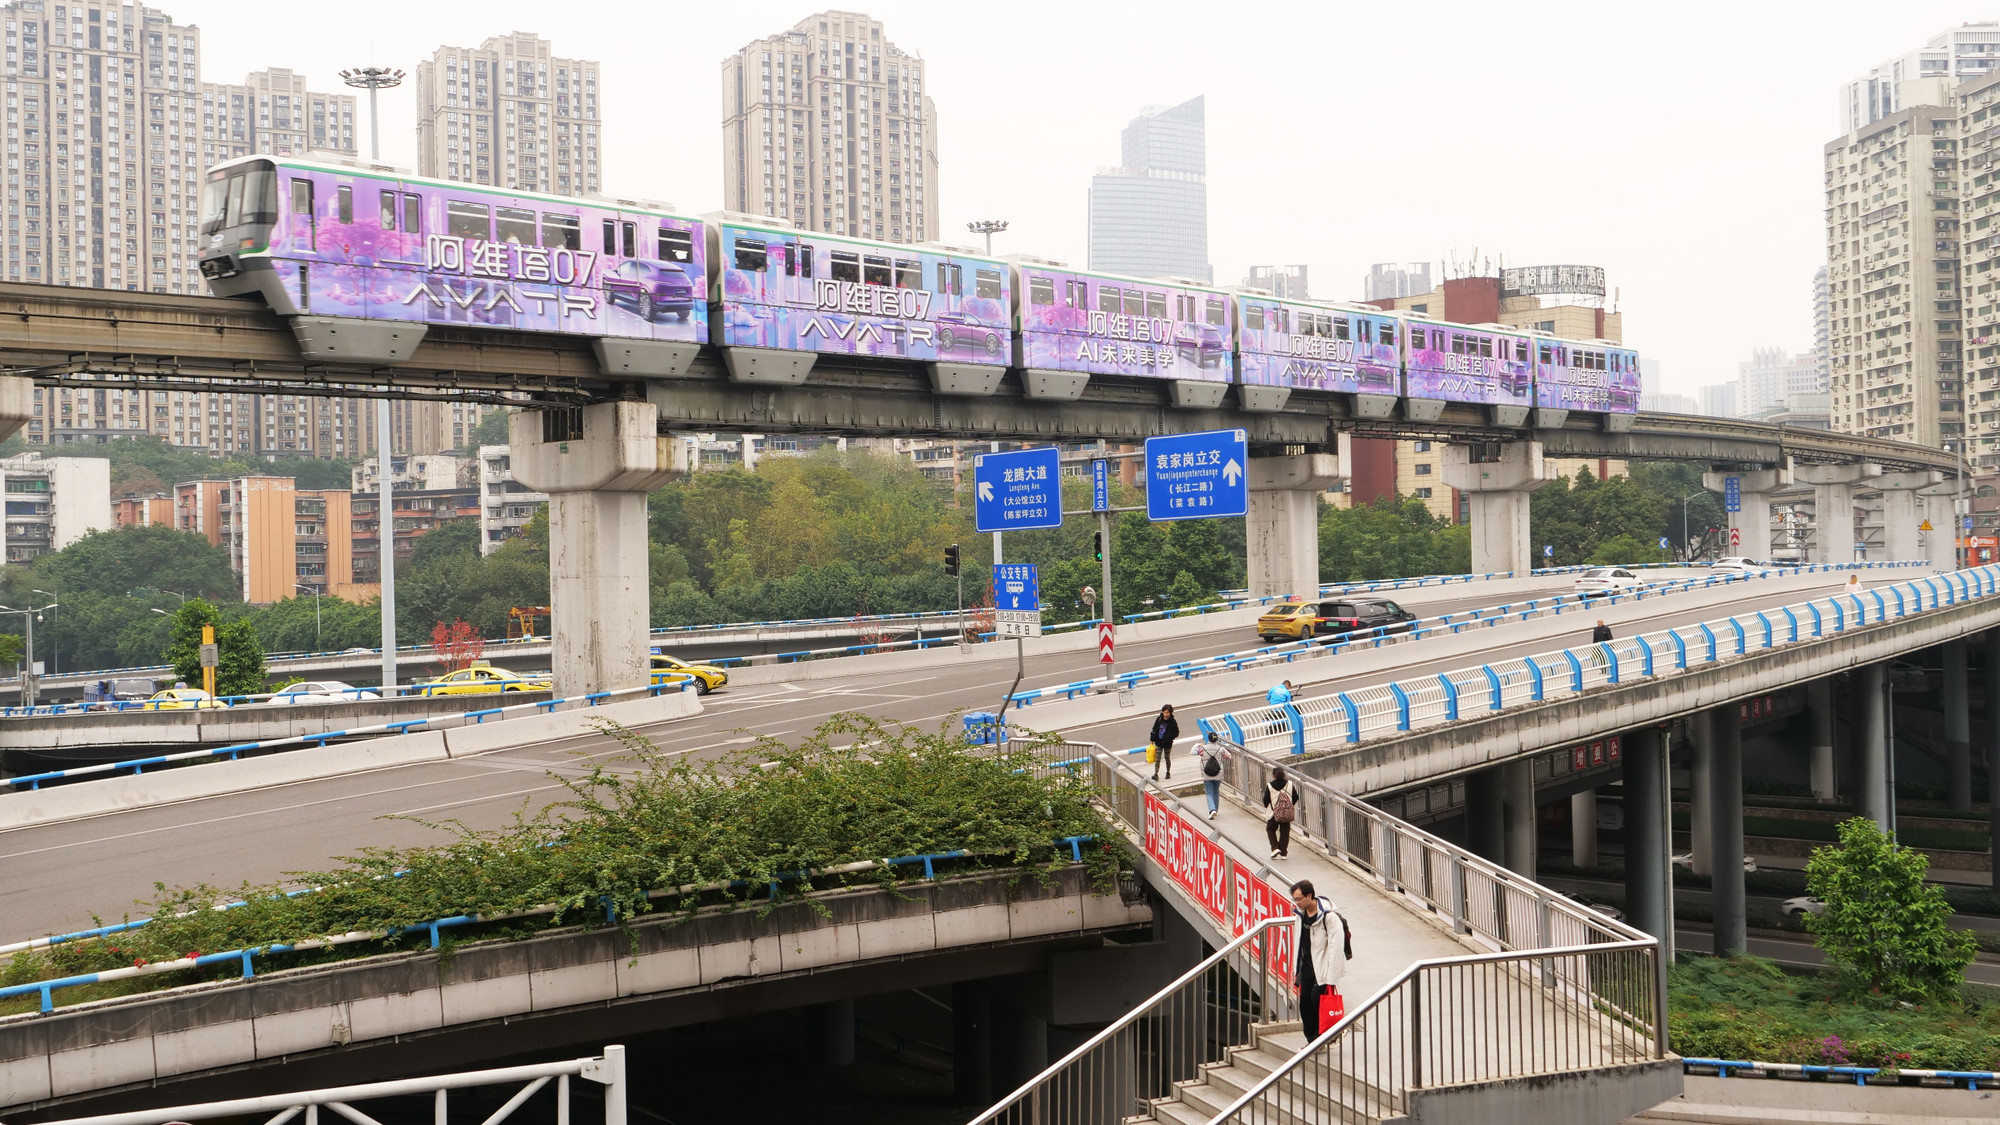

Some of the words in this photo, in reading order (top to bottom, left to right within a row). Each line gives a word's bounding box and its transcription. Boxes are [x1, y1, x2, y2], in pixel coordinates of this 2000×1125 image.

[427, 233, 597, 286] 阿维塔07
[402, 281, 597, 320] AVATR
[815, 278, 933, 320] 阿维塔07
[800, 317, 933, 347] AVATR
[1088, 310, 1174, 345] 阿维塔07
[1077, 340, 1174, 369] AI未来美学
[1290, 334, 1355, 363] 阿维塔07
[1281, 362, 1356, 383] AVATR
[1445, 352, 1496, 378] 阿维塔07
[1438, 378, 1497, 396] AVATR
[1003, 465, 1047, 483] 龙腾大道
[1156, 449, 1221, 470] 袁家岗立交
[1001, 566, 1029, 580] 公交专用
[1006, 623, 1030, 635] 工作日
[1146, 800, 1226, 914] 中国式现代化
